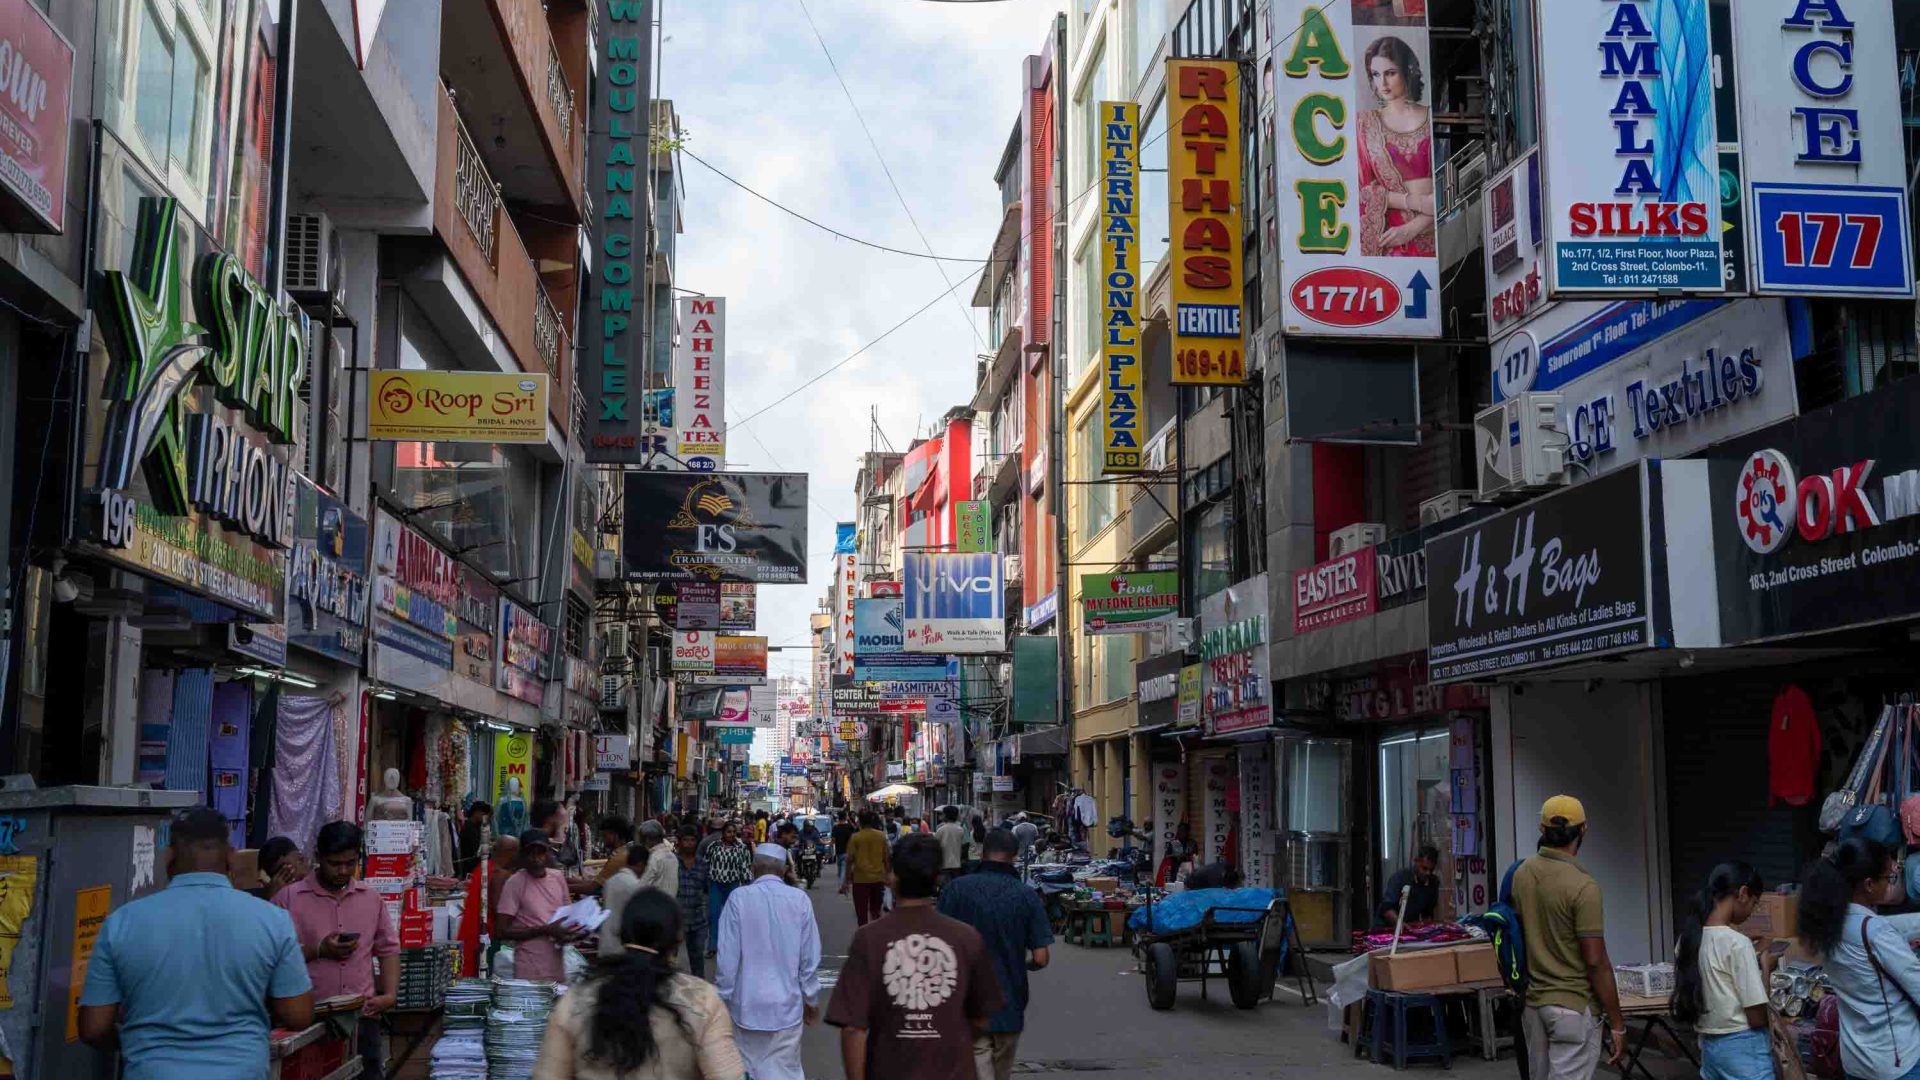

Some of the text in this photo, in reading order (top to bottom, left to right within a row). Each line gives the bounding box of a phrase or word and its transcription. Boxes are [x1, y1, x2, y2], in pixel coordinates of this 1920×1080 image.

[604, 37, 639, 219] MOULANA
[1284, 8, 1350, 255] ACE
[1179, 65, 1232, 289] RATHAS
[1568, 202, 1709, 237] SILKS
[1493, 223, 1516, 249] PALACE
[1775, 211, 1883, 270] 177
[1561, 248, 1717, 261] No.177, 1/2, First Floor, Noor Plaza,
[1571, 261, 1708, 273] 2nd Cross Street, Colombo-11.
[1105, 105, 1138, 449] INTERNATIONAL PLAZA
[1603, 274, 1679, 285] Tel 011 2471588
[1300, 286, 1385, 312] 177/1
[599, 234, 632, 421] COMPLEX
[1177, 306, 1241, 334] TEXTILE
[1547, 341, 1592, 374] Showroom
[1604, 322, 1629, 345] Floor
[690, 300, 715, 428] MAHEEZA
[1177, 348, 1242, 378] 169-1A
[1504, 346, 1530, 384] 177
[417, 388, 535, 419] Roop Sri
[1626, 345, 1764, 440] Textiles
[683, 431, 719, 442] TEX
[688, 461, 715, 469] 168 2/3
[1108, 452, 1138, 467] 169
[1752, 489, 1769, 506] OK
[1796, 459, 1878, 541] OK
[100, 487, 136, 549] 196
[915, 571, 992, 593] vivo
[1297, 556, 1358, 608] EASTER
[1453, 510, 1602, 629] H & H Bags
[1750, 574, 1770, 590] 183,
[1769, 567, 1788, 588] 2nd
[1789, 562, 1818, 583] Cross
[1821, 555, 1856, 575] Street
[682, 586, 716, 596] Beauty
[682, 594, 717, 602] Centre
[1085, 594, 1179, 610] MY FONE CENTER
[1118, 582, 1153, 595] Fone
[1487, 633, 1494, 644] &
[1495, 626, 1512, 641] Retail
[1512, 623, 1537, 639] Dealers
[1545, 616, 1556, 630] All
[1556, 612, 1577, 629] Kinds
[1579, 609, 1587, 625] of
[1588, 603, 1614, 621] Ladies
[1614, 600, 1637, 619] Bags
[1581, 639, 1592, 651] 222
[1597, 635, 1610, 649] 077
[1461, 661, 1480, 674] CROSS
[1500, 652, 1528, 669] COLOMBO
[833, 688, 864, 700] CENTER
[891, 682, 948, 693] HASMITHA'S
